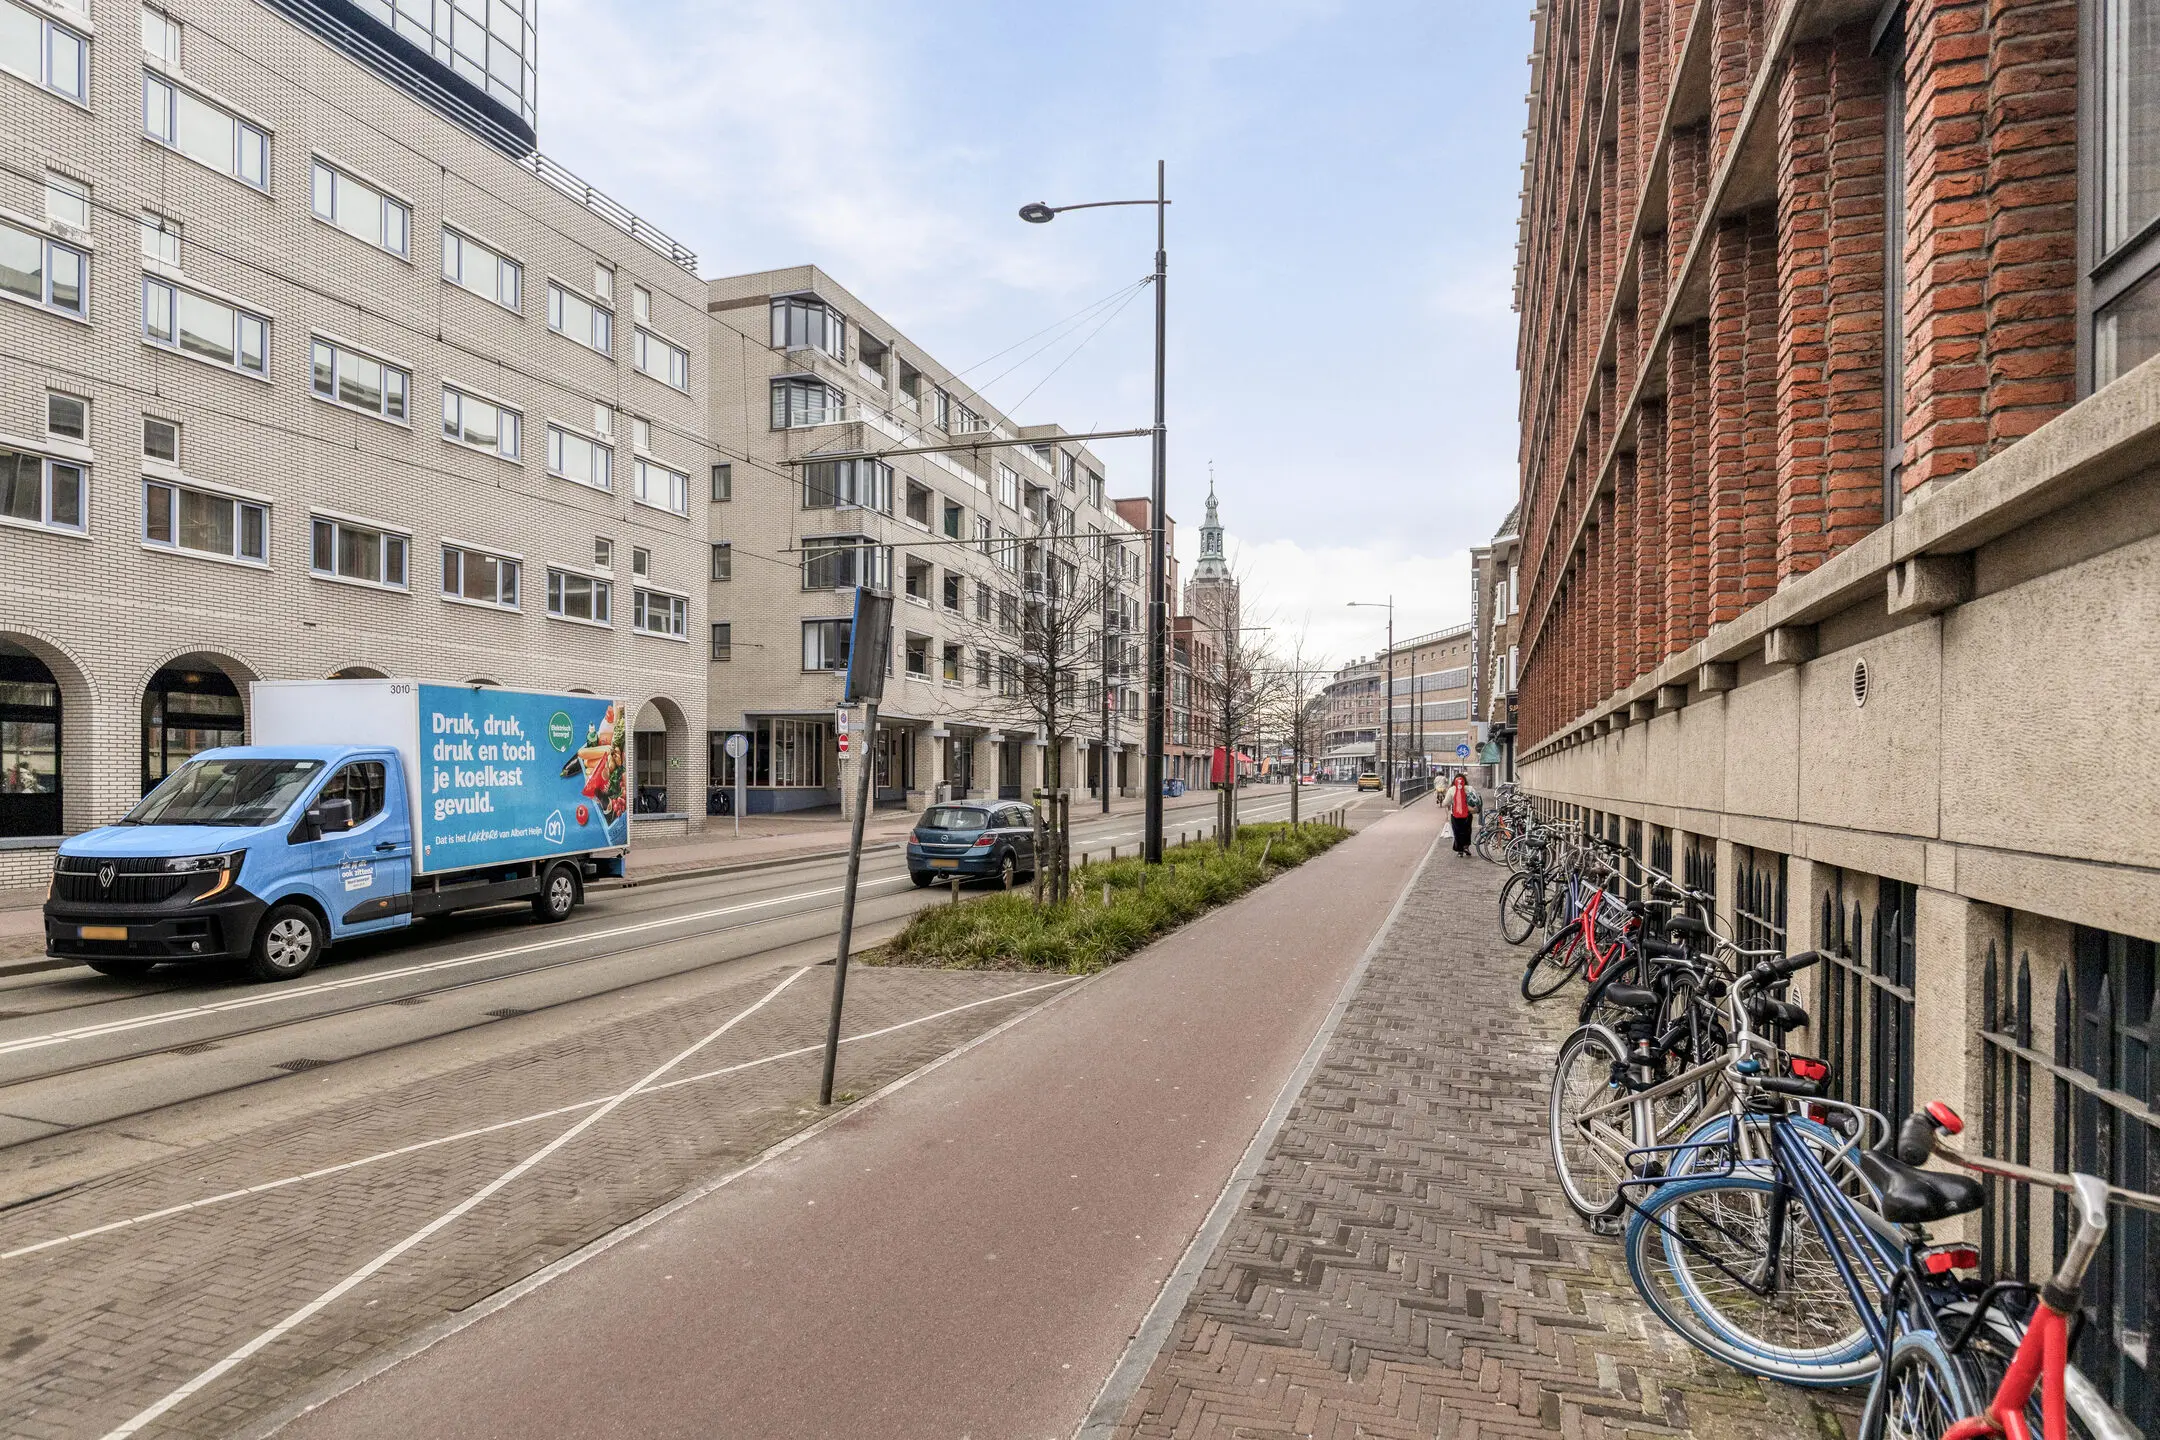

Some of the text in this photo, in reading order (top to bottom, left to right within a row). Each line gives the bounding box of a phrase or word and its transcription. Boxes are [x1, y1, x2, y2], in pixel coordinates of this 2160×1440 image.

[390, 684, 411, 694] 3010
[432, 712, 525, 741] Druk, druk,
[433, 738, 535, 761] druk en toch
[432, 765, 523, 794] je koelkast
[434, 791, 495, 821] gevuld.
[435, 835, 448, 845] Dat
[448, 834, 455, 844] is
[455, 833, 467, 843] het
[510, 828, 528, 838] Albert
[528, 826, 543, 836] Heijn
